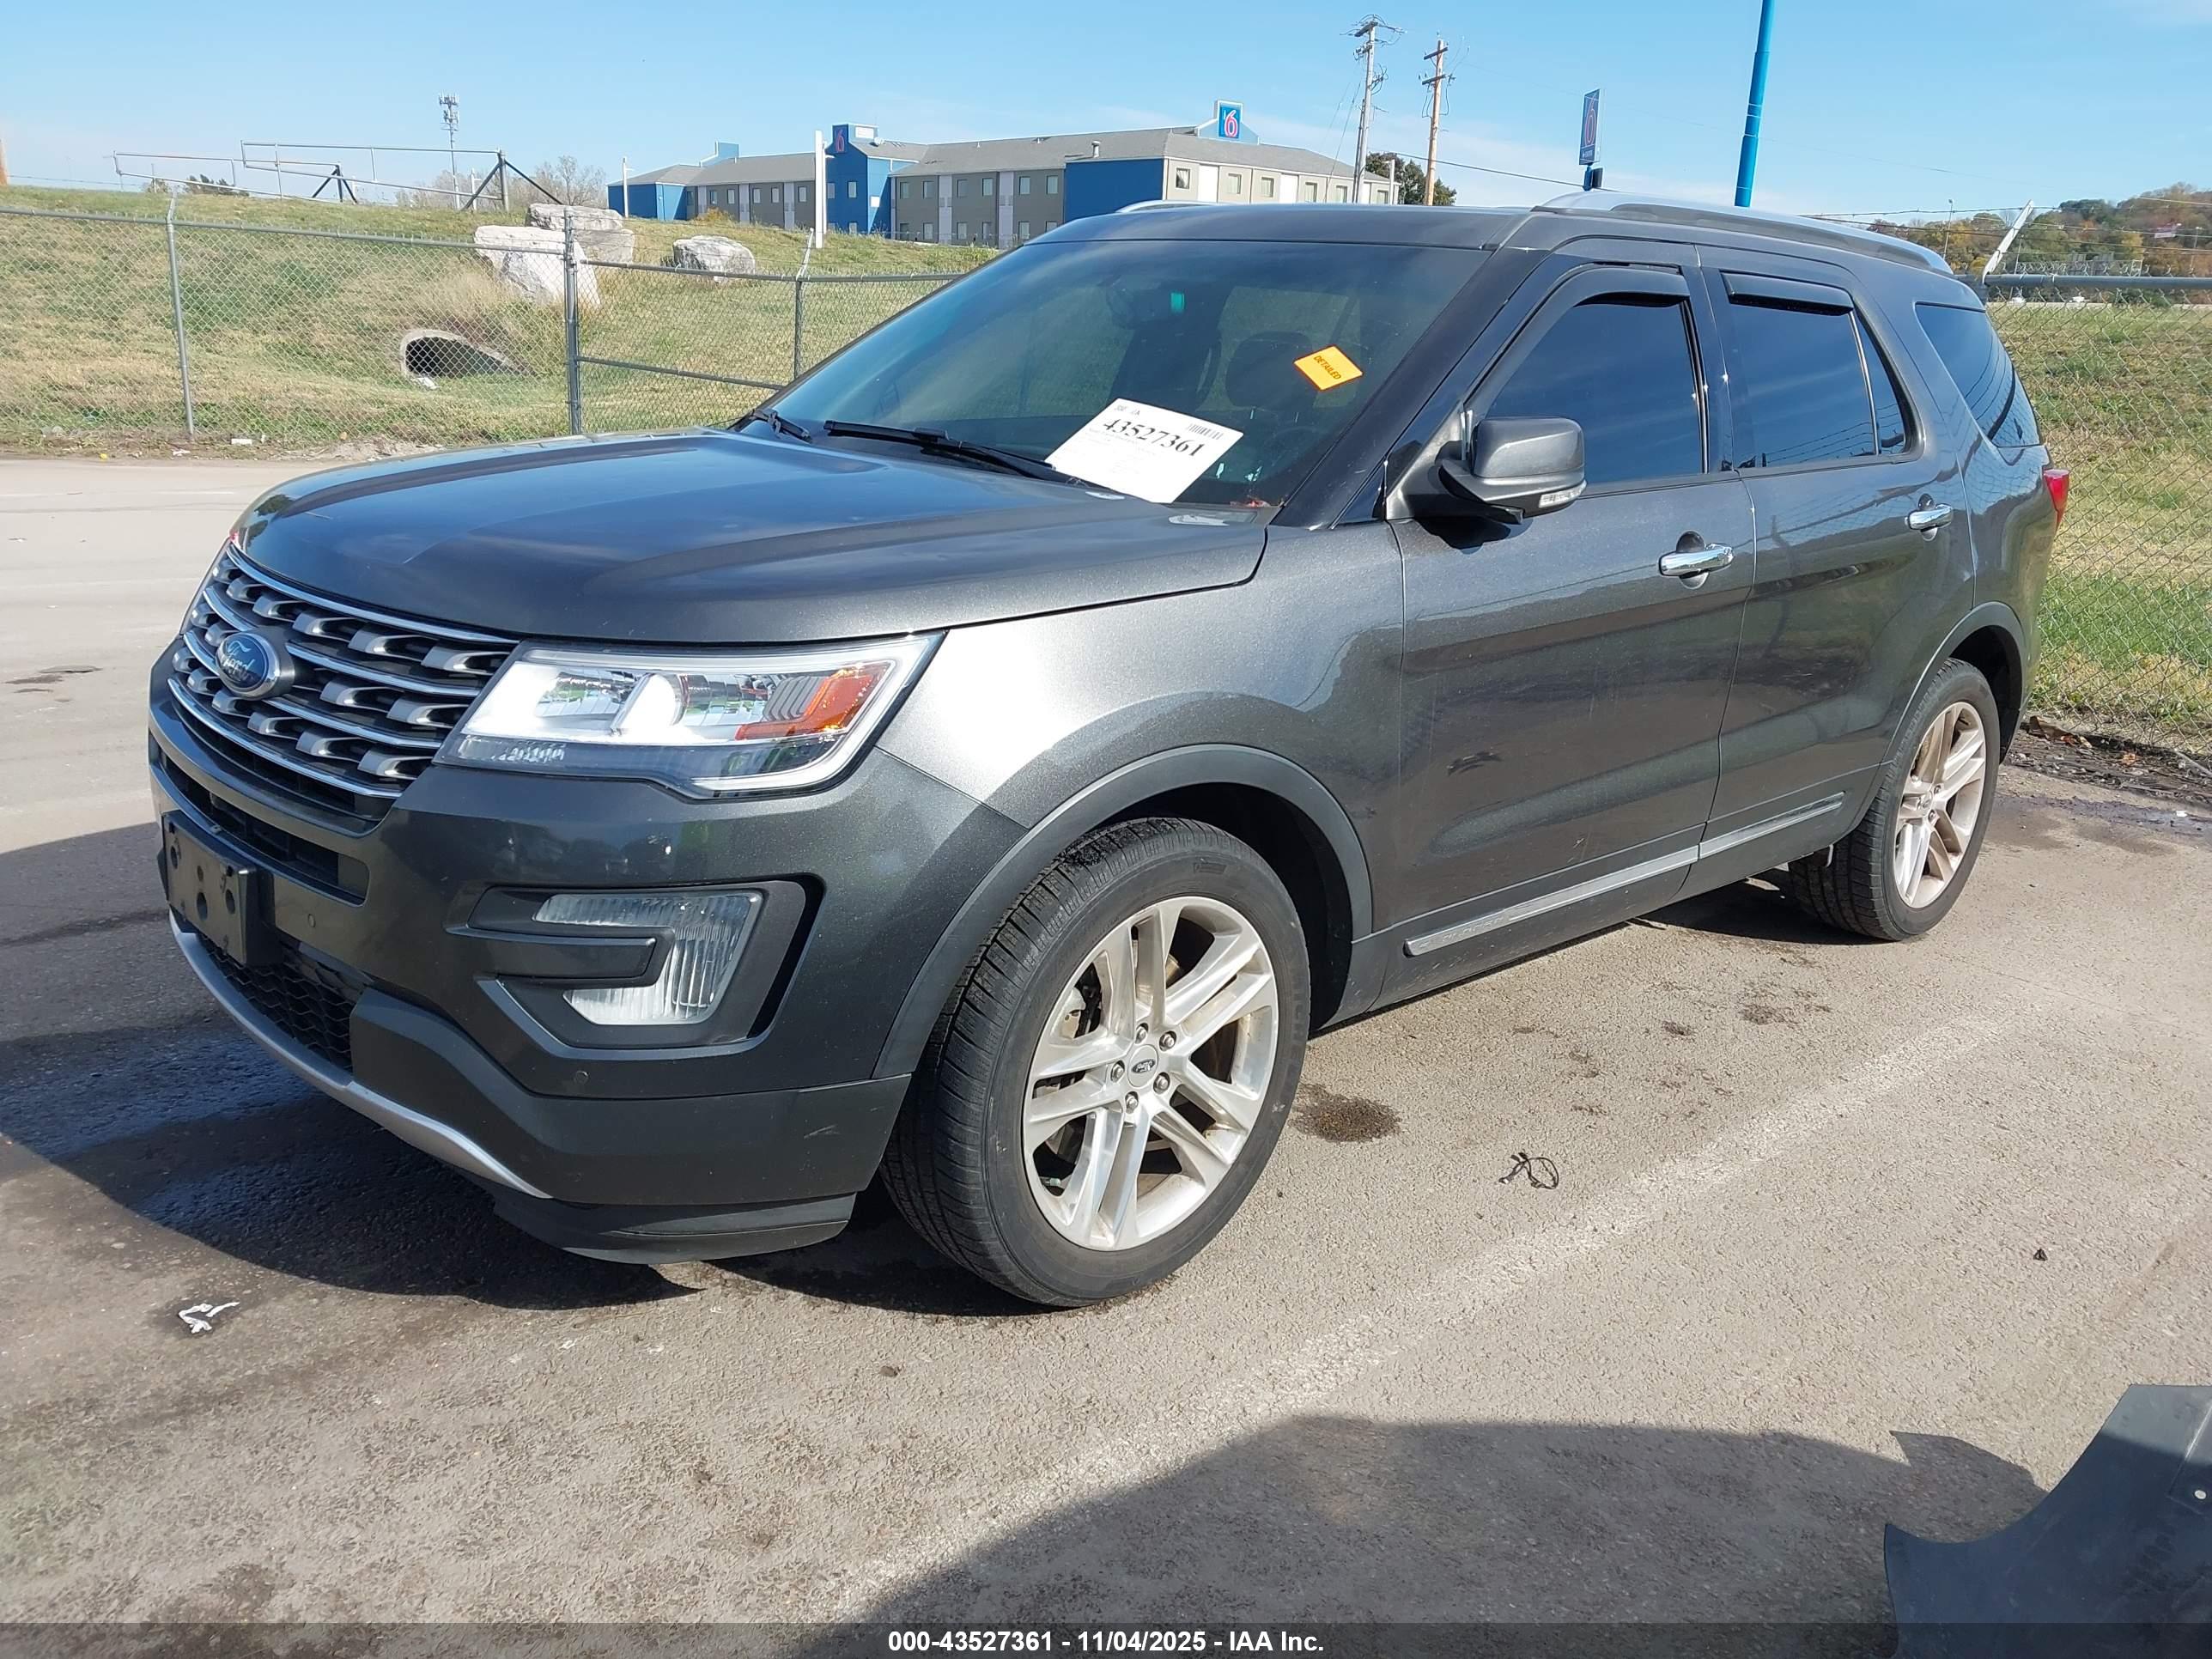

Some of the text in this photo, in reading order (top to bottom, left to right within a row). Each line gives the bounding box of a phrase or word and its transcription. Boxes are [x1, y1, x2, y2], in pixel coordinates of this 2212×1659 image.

[1224, 109, 1238, 137] 6
[1313, 355, 1342, 380] DETAILED
[1103, 419, 1205, 456] 43527361
[222, 640, 256, 675] Ford
